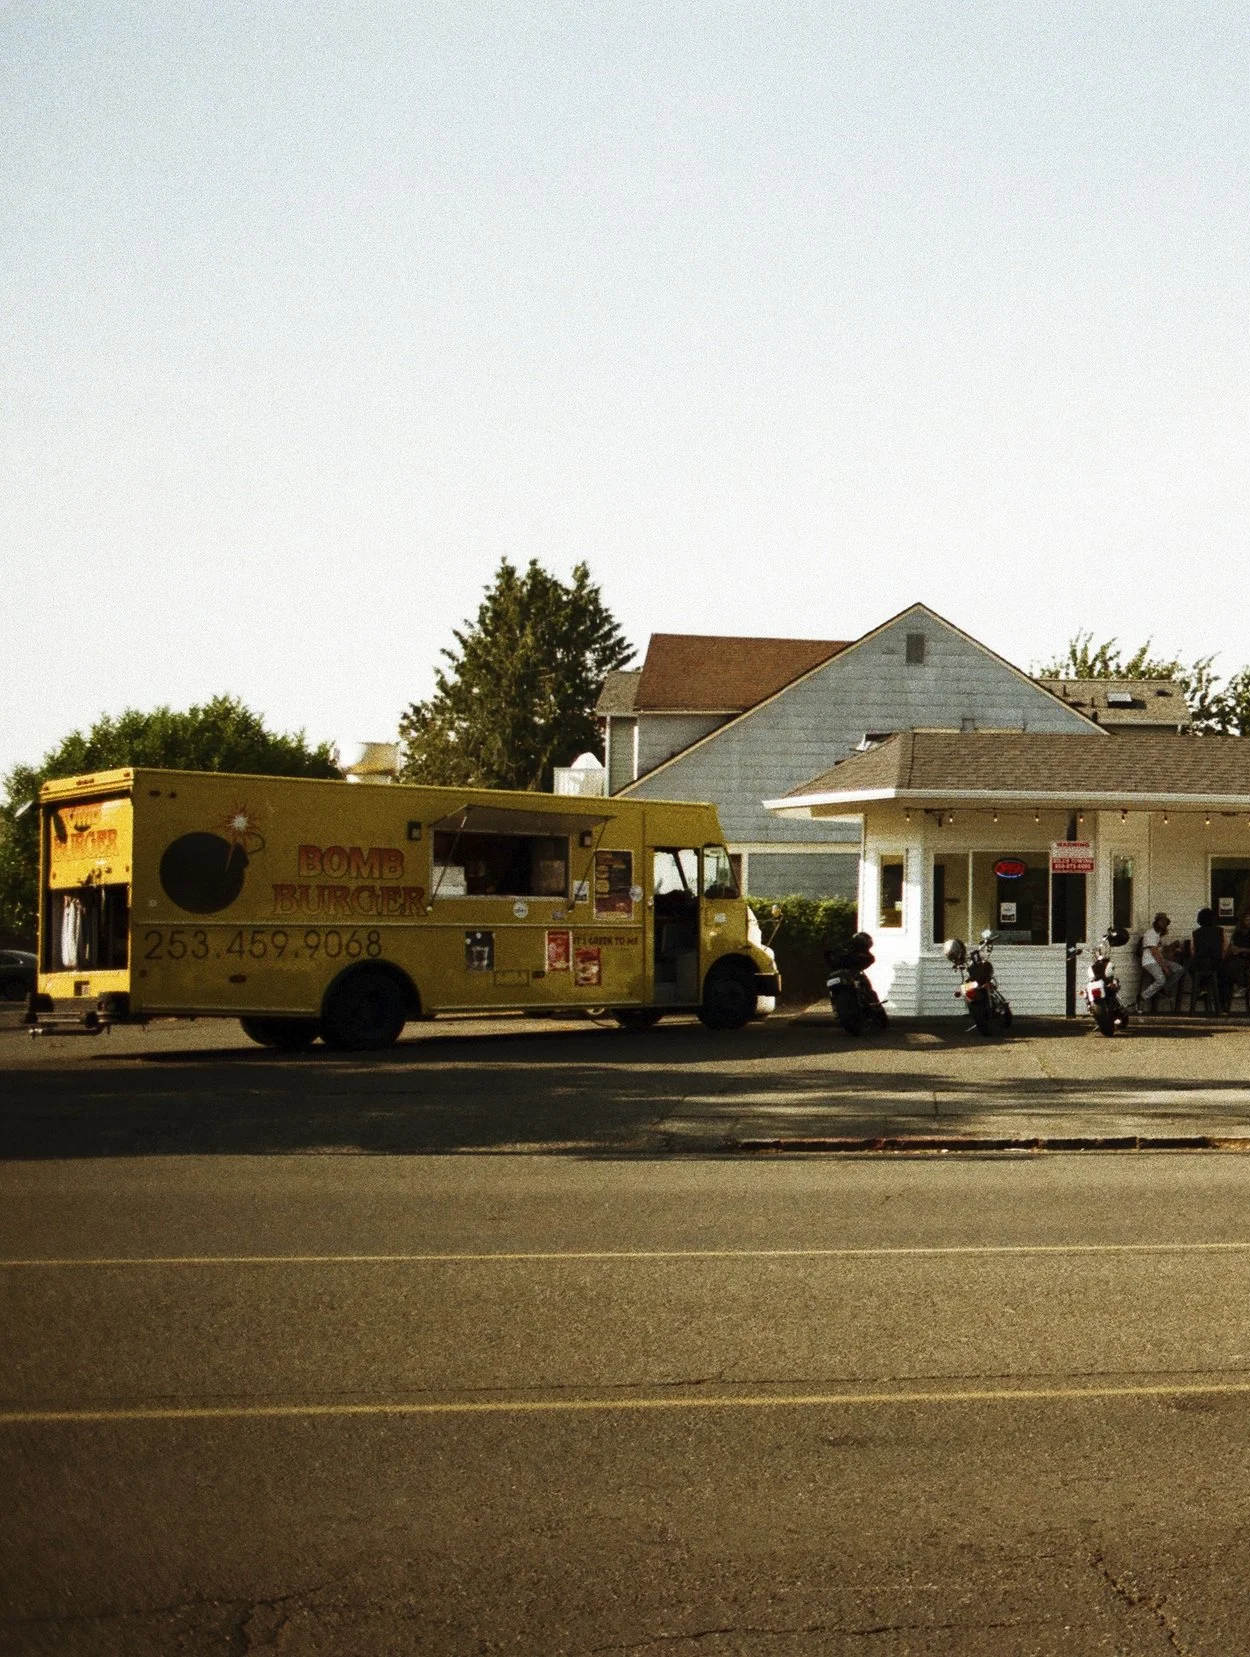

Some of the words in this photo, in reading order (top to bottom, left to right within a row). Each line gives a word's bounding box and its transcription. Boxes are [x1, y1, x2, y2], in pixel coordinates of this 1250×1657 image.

[298, 844, 405, 880] BOMB
[271, 883, 429, 917] BURGER
[144, 929, 383, 961] 253.459.9068
